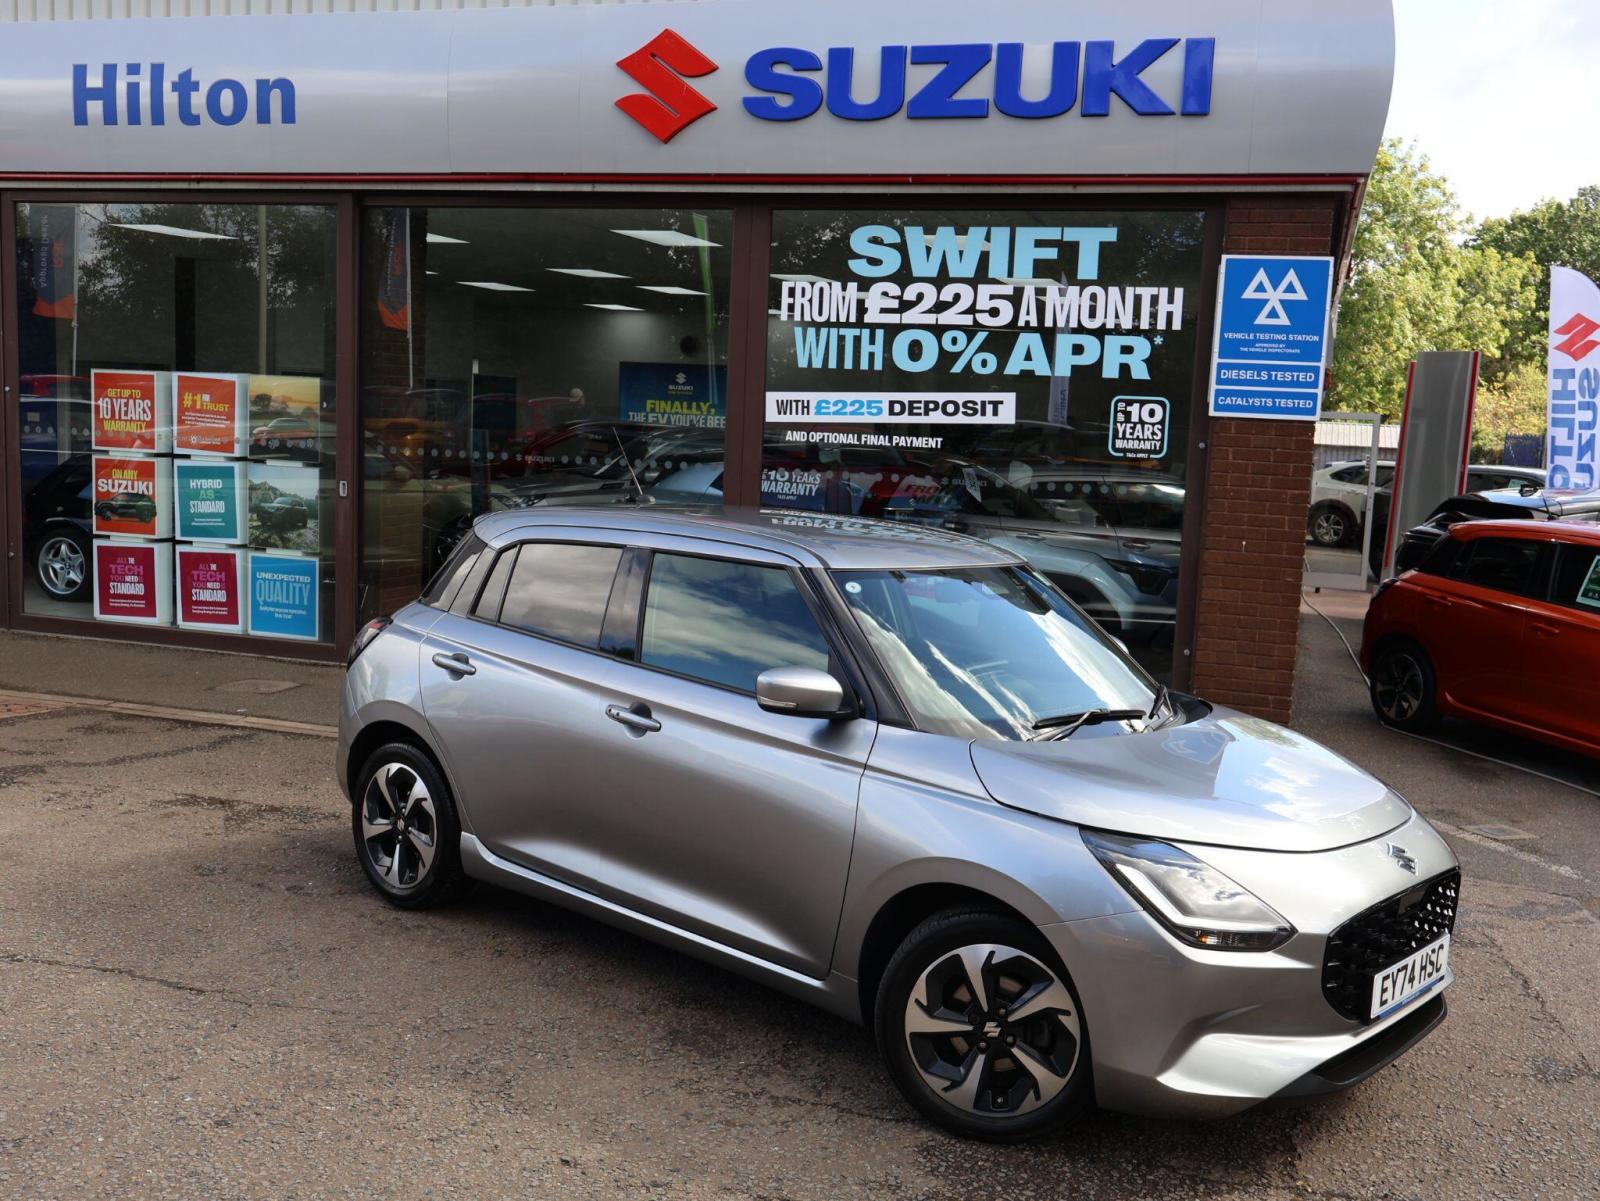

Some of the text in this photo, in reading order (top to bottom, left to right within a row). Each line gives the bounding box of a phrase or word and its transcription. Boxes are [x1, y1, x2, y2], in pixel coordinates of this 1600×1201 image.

[742, 37, 1216, 122] SUZUKI
[72, 62, 297, 126] Hilton
[847, 224, 1118, 280] SWIFT
[779, 281, 1185, 330] FROM £225 A MONTH
[1224, 332, 1319, 342] VEHICLE TESTING STATION
[793, 326, 885, 371] WITH
[891, 328, 998, 375] 0%
[1220, 369, 1315, 382] DIESELS TESTED
[107, 388, 141, 399] GET UP TO
[99, 397, 152, 421] 10 YEARS
[202, 402, 229, 412] TRUST
[646, 400, 718, 416] FINALLY,
[776, 399, 1004, 417] WITH £225 DEPOSIT
[1218, 396, 1313, 408] CATALYSTS TESTED
[628, 412, 647, 423] THE
[670, 414, 706, 428] YOU'VE
[1117, 412, 1125, 422] UP
[1126, 403, 1164, 424] 10
[103, 420, 147, 433] WARRANTY
[1116, 423, 1162, 440] YEARS
[785, 430, 943, 449] AND OPTIONAL FINAL PAYMENT
[1115, 439, 1161, 450] WARRANTY
[112, 468, 138, 480] ON ANY
[792, 471, 822, 485] YEARS
[97, 478, 153, 496] SUZUKI
[190, 478, 223, 489] HYBRID
[761, 480, 819, 496] WARRANTY
[199, 489, 215, 500] AS
[189, 500, 226, 513] STANDARD
[109, 564, 144, 576] TECH
[191, 570, 226, 582] TECH
[256, 571, 311, 583] UNEXPECTED
[125, 575, 139, 583] NEED
[207, 582, 221, 590] NEED
[109, 582, 145, 596] STANDARD
[191, 588, 227, 602] STANDARD
[256, 579, 311, 606] QUALITY
[1379, 943, 1445, 1008] EY74 HSC
